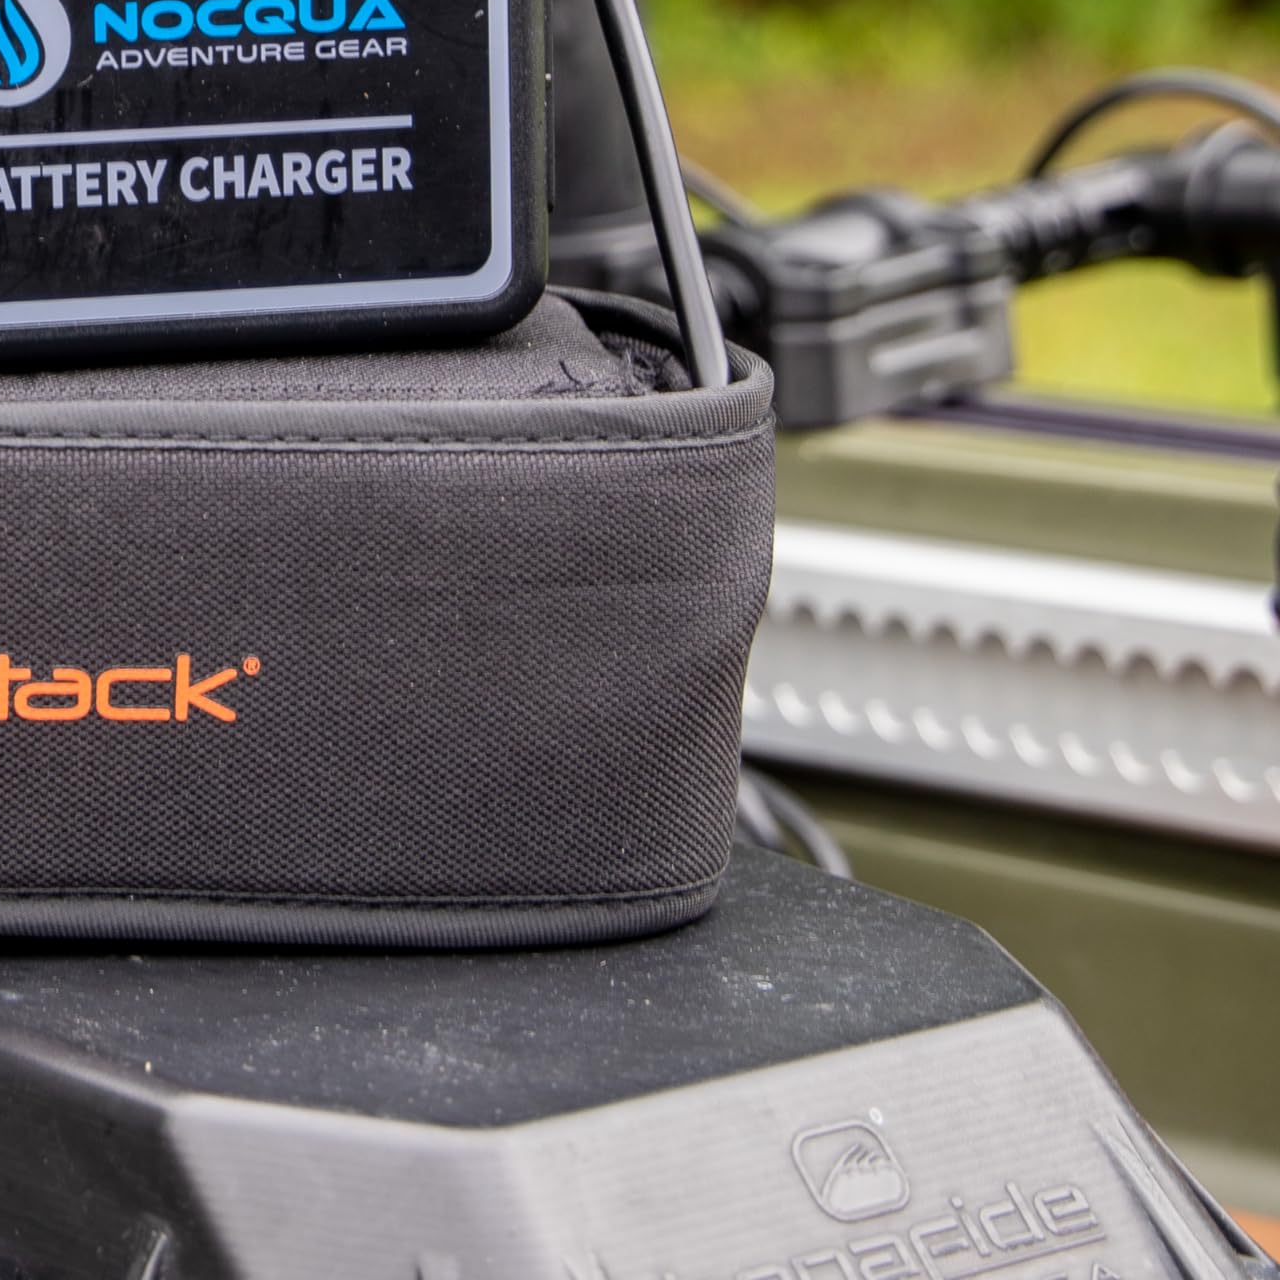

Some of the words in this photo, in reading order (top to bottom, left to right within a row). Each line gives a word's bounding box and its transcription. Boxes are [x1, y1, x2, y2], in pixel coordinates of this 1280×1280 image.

[96, 41, 306, 70] ADVENTURE
[315, 37, 408, 59] GEAR
[180, 147, 414, 202] CHARGER
